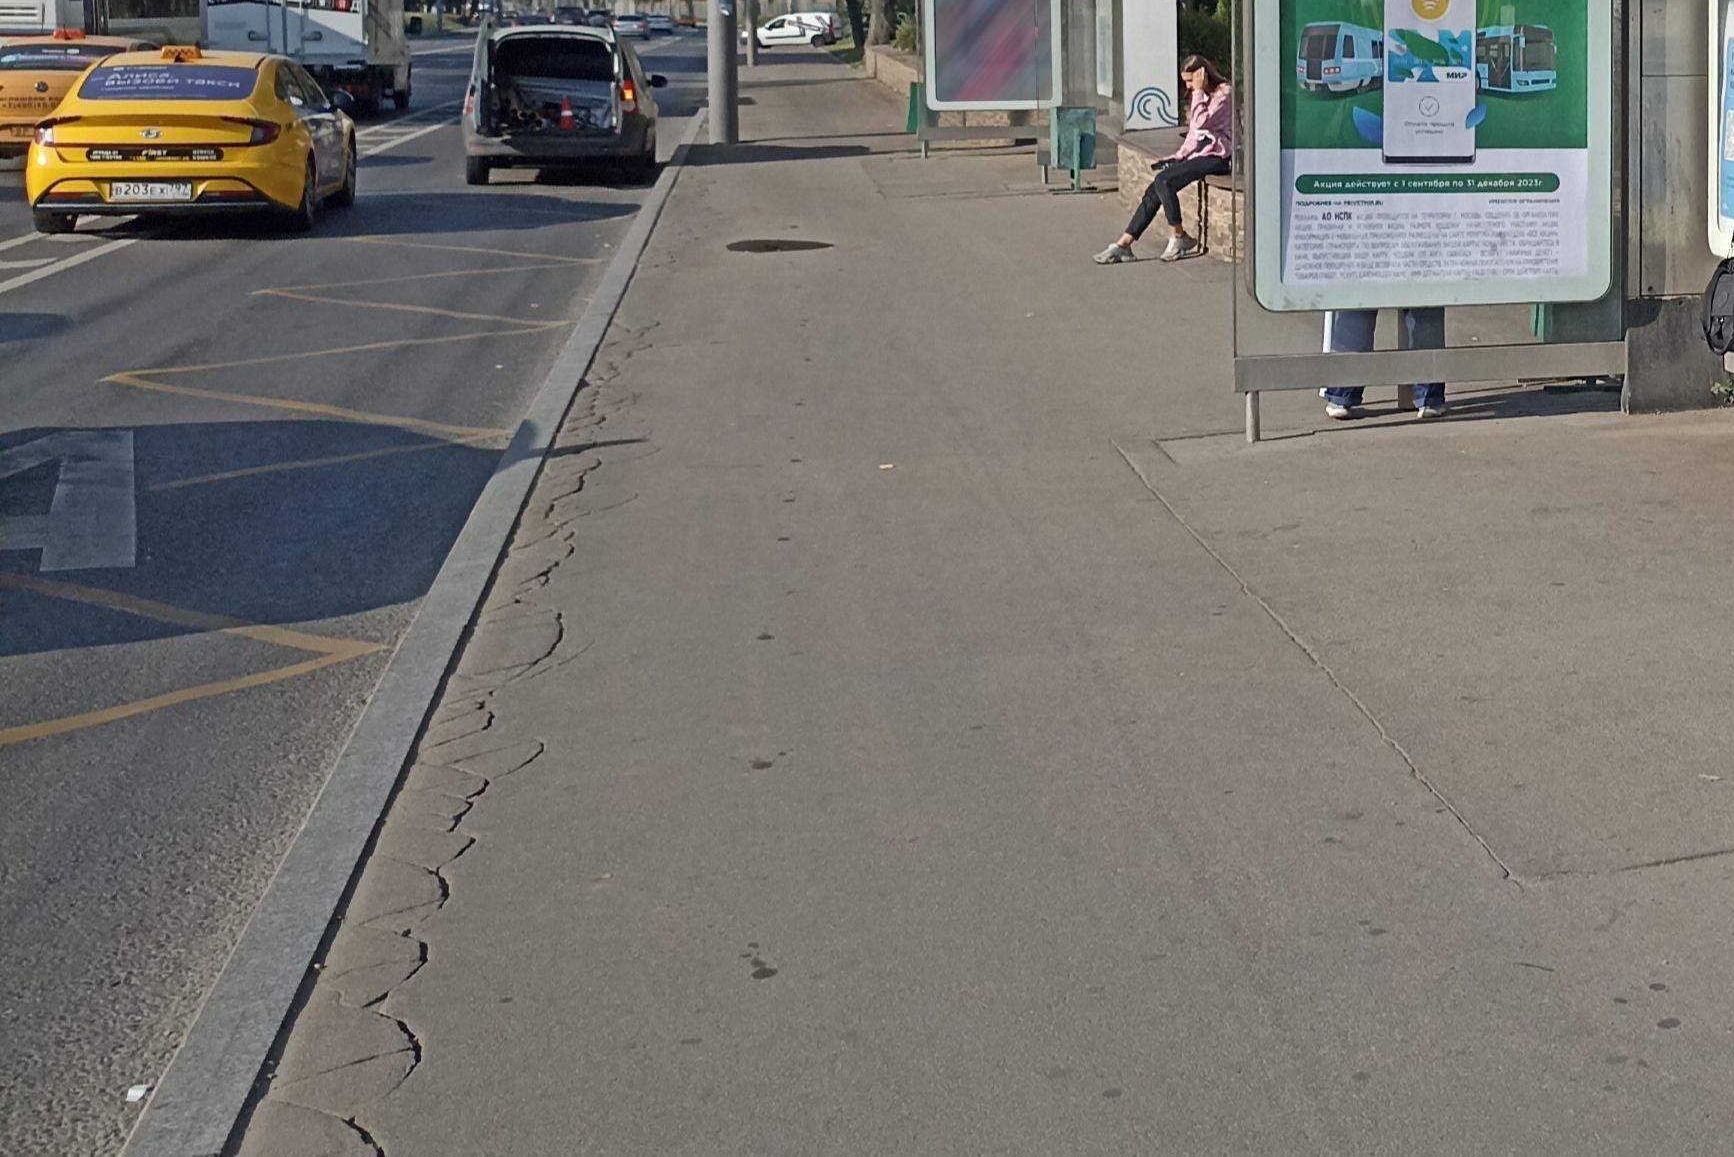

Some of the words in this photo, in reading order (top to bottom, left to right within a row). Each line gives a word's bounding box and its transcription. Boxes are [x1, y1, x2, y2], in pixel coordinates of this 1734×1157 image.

[1313, 180, 1342, 188] Акция
[1408, 179, 1450, 189] сентября
[1477, 179, 1515, 188] декабря
